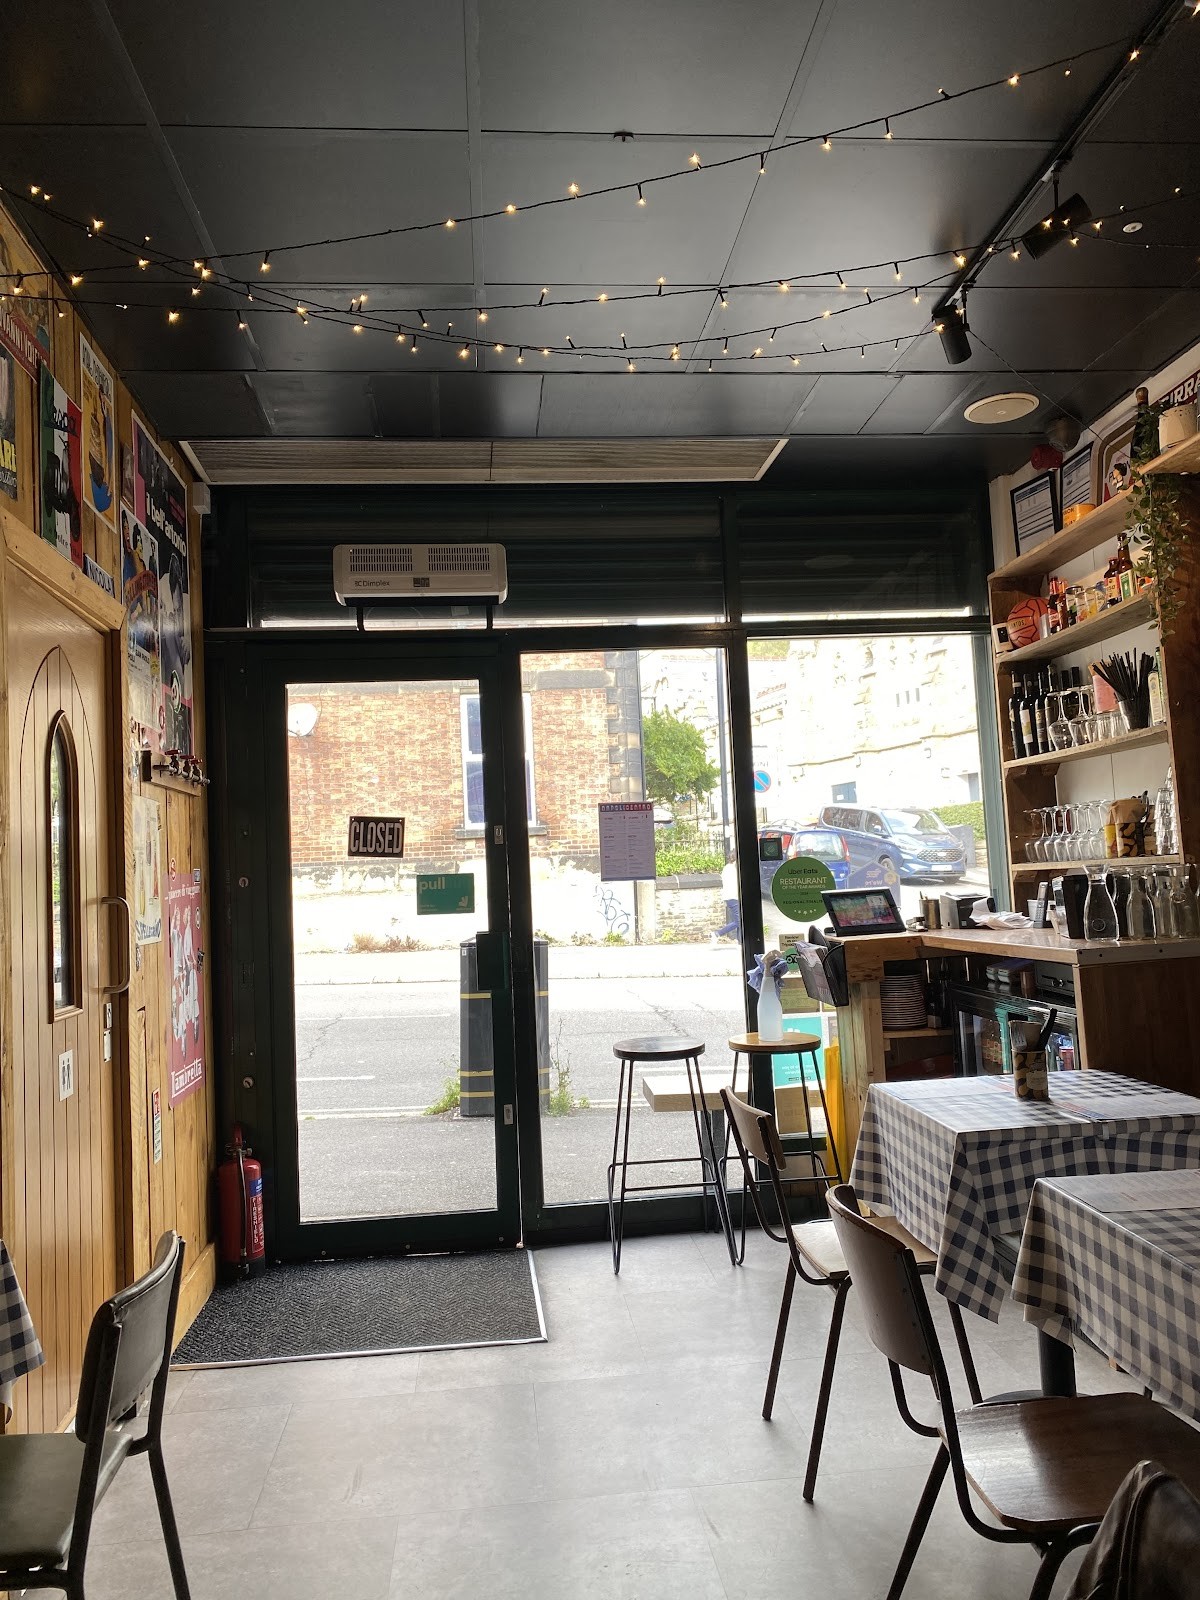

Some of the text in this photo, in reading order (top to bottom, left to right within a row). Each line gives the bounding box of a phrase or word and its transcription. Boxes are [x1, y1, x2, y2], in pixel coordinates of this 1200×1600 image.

[350, 821, 403, 854] CLOSED
[419, 877, 446, 894] pull
[780, 877, 827, 885] RESTAURANT
